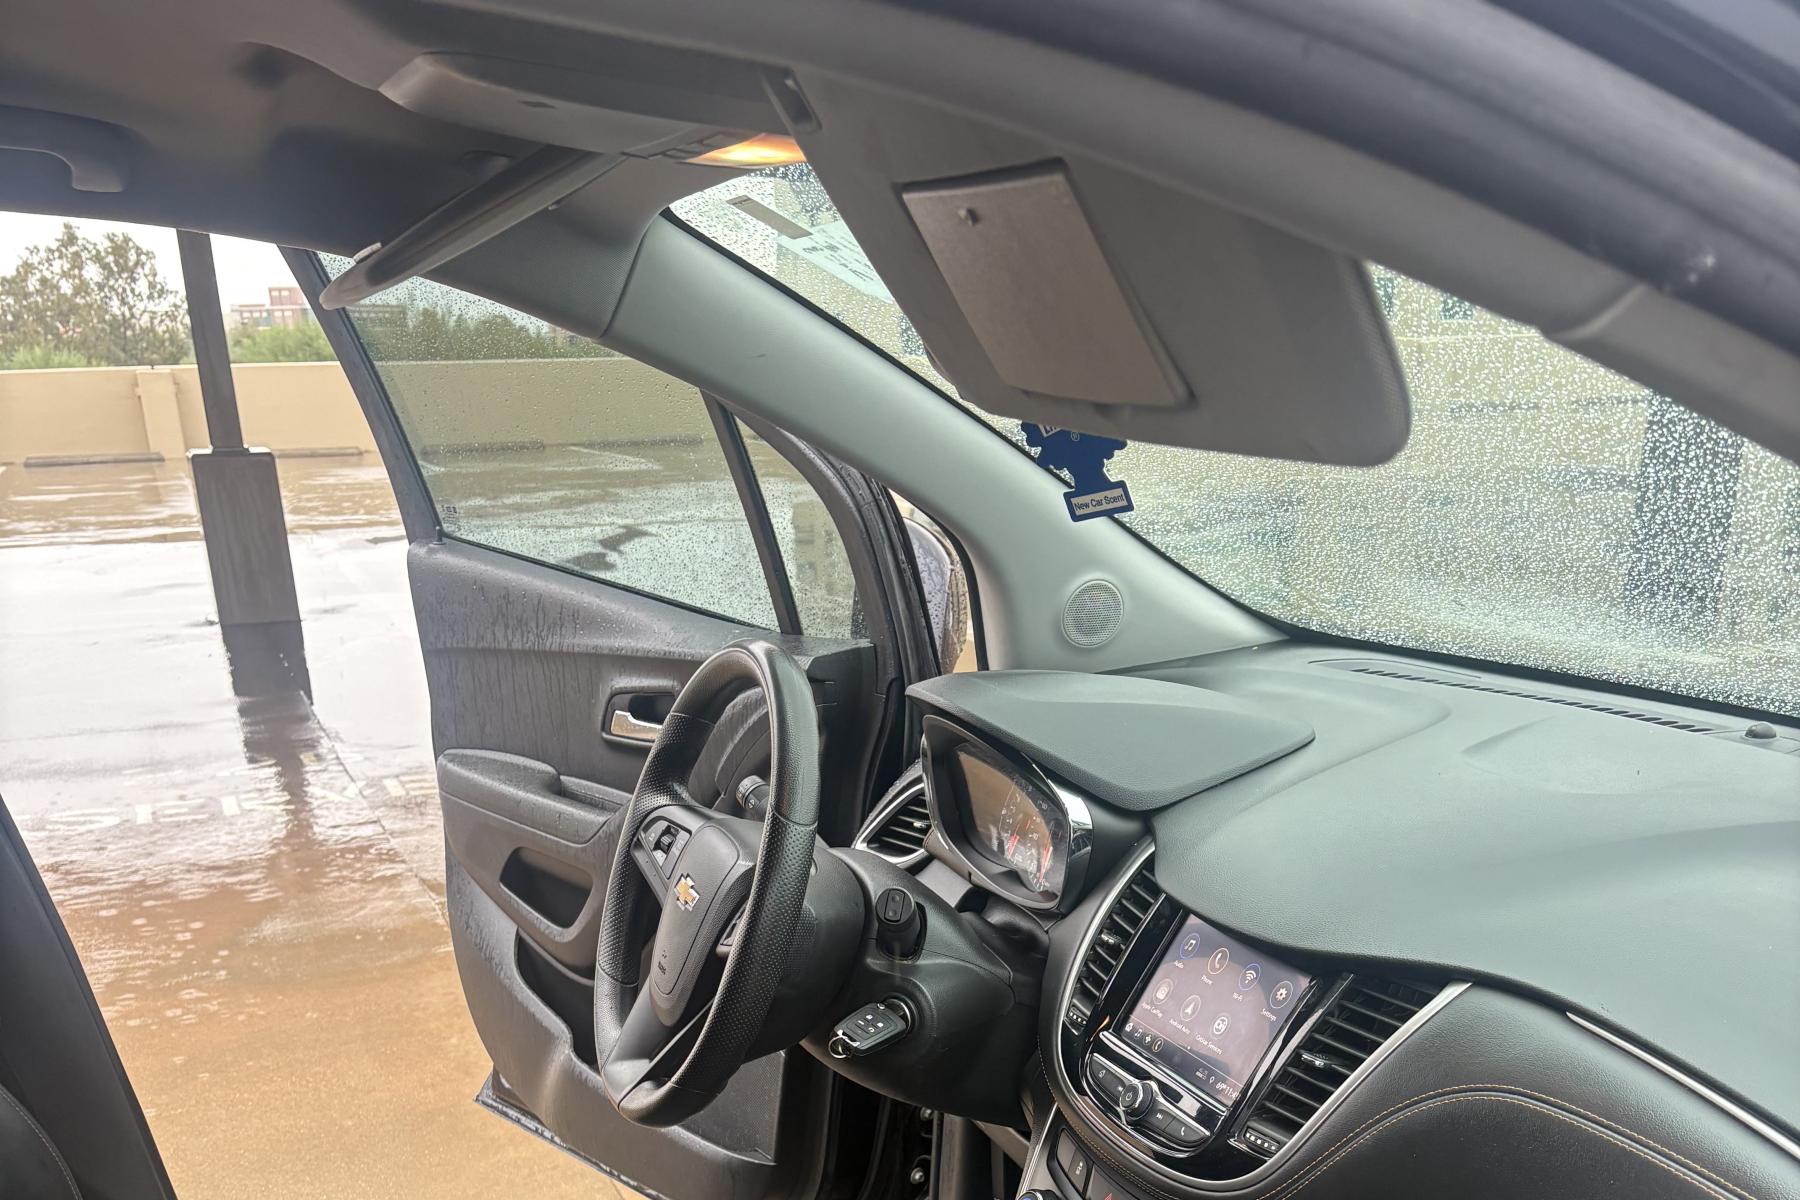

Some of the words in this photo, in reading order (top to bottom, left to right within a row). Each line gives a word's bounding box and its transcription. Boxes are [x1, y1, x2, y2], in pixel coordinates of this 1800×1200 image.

[1074, 502, 1090, 511] New
[1090, 498, 1103, 507] Car
[1103, 494, 1125, 505] Scent
[1201, 974, 1213, 985] Phone
[1261, 1008, 1277, 1022] Settings
